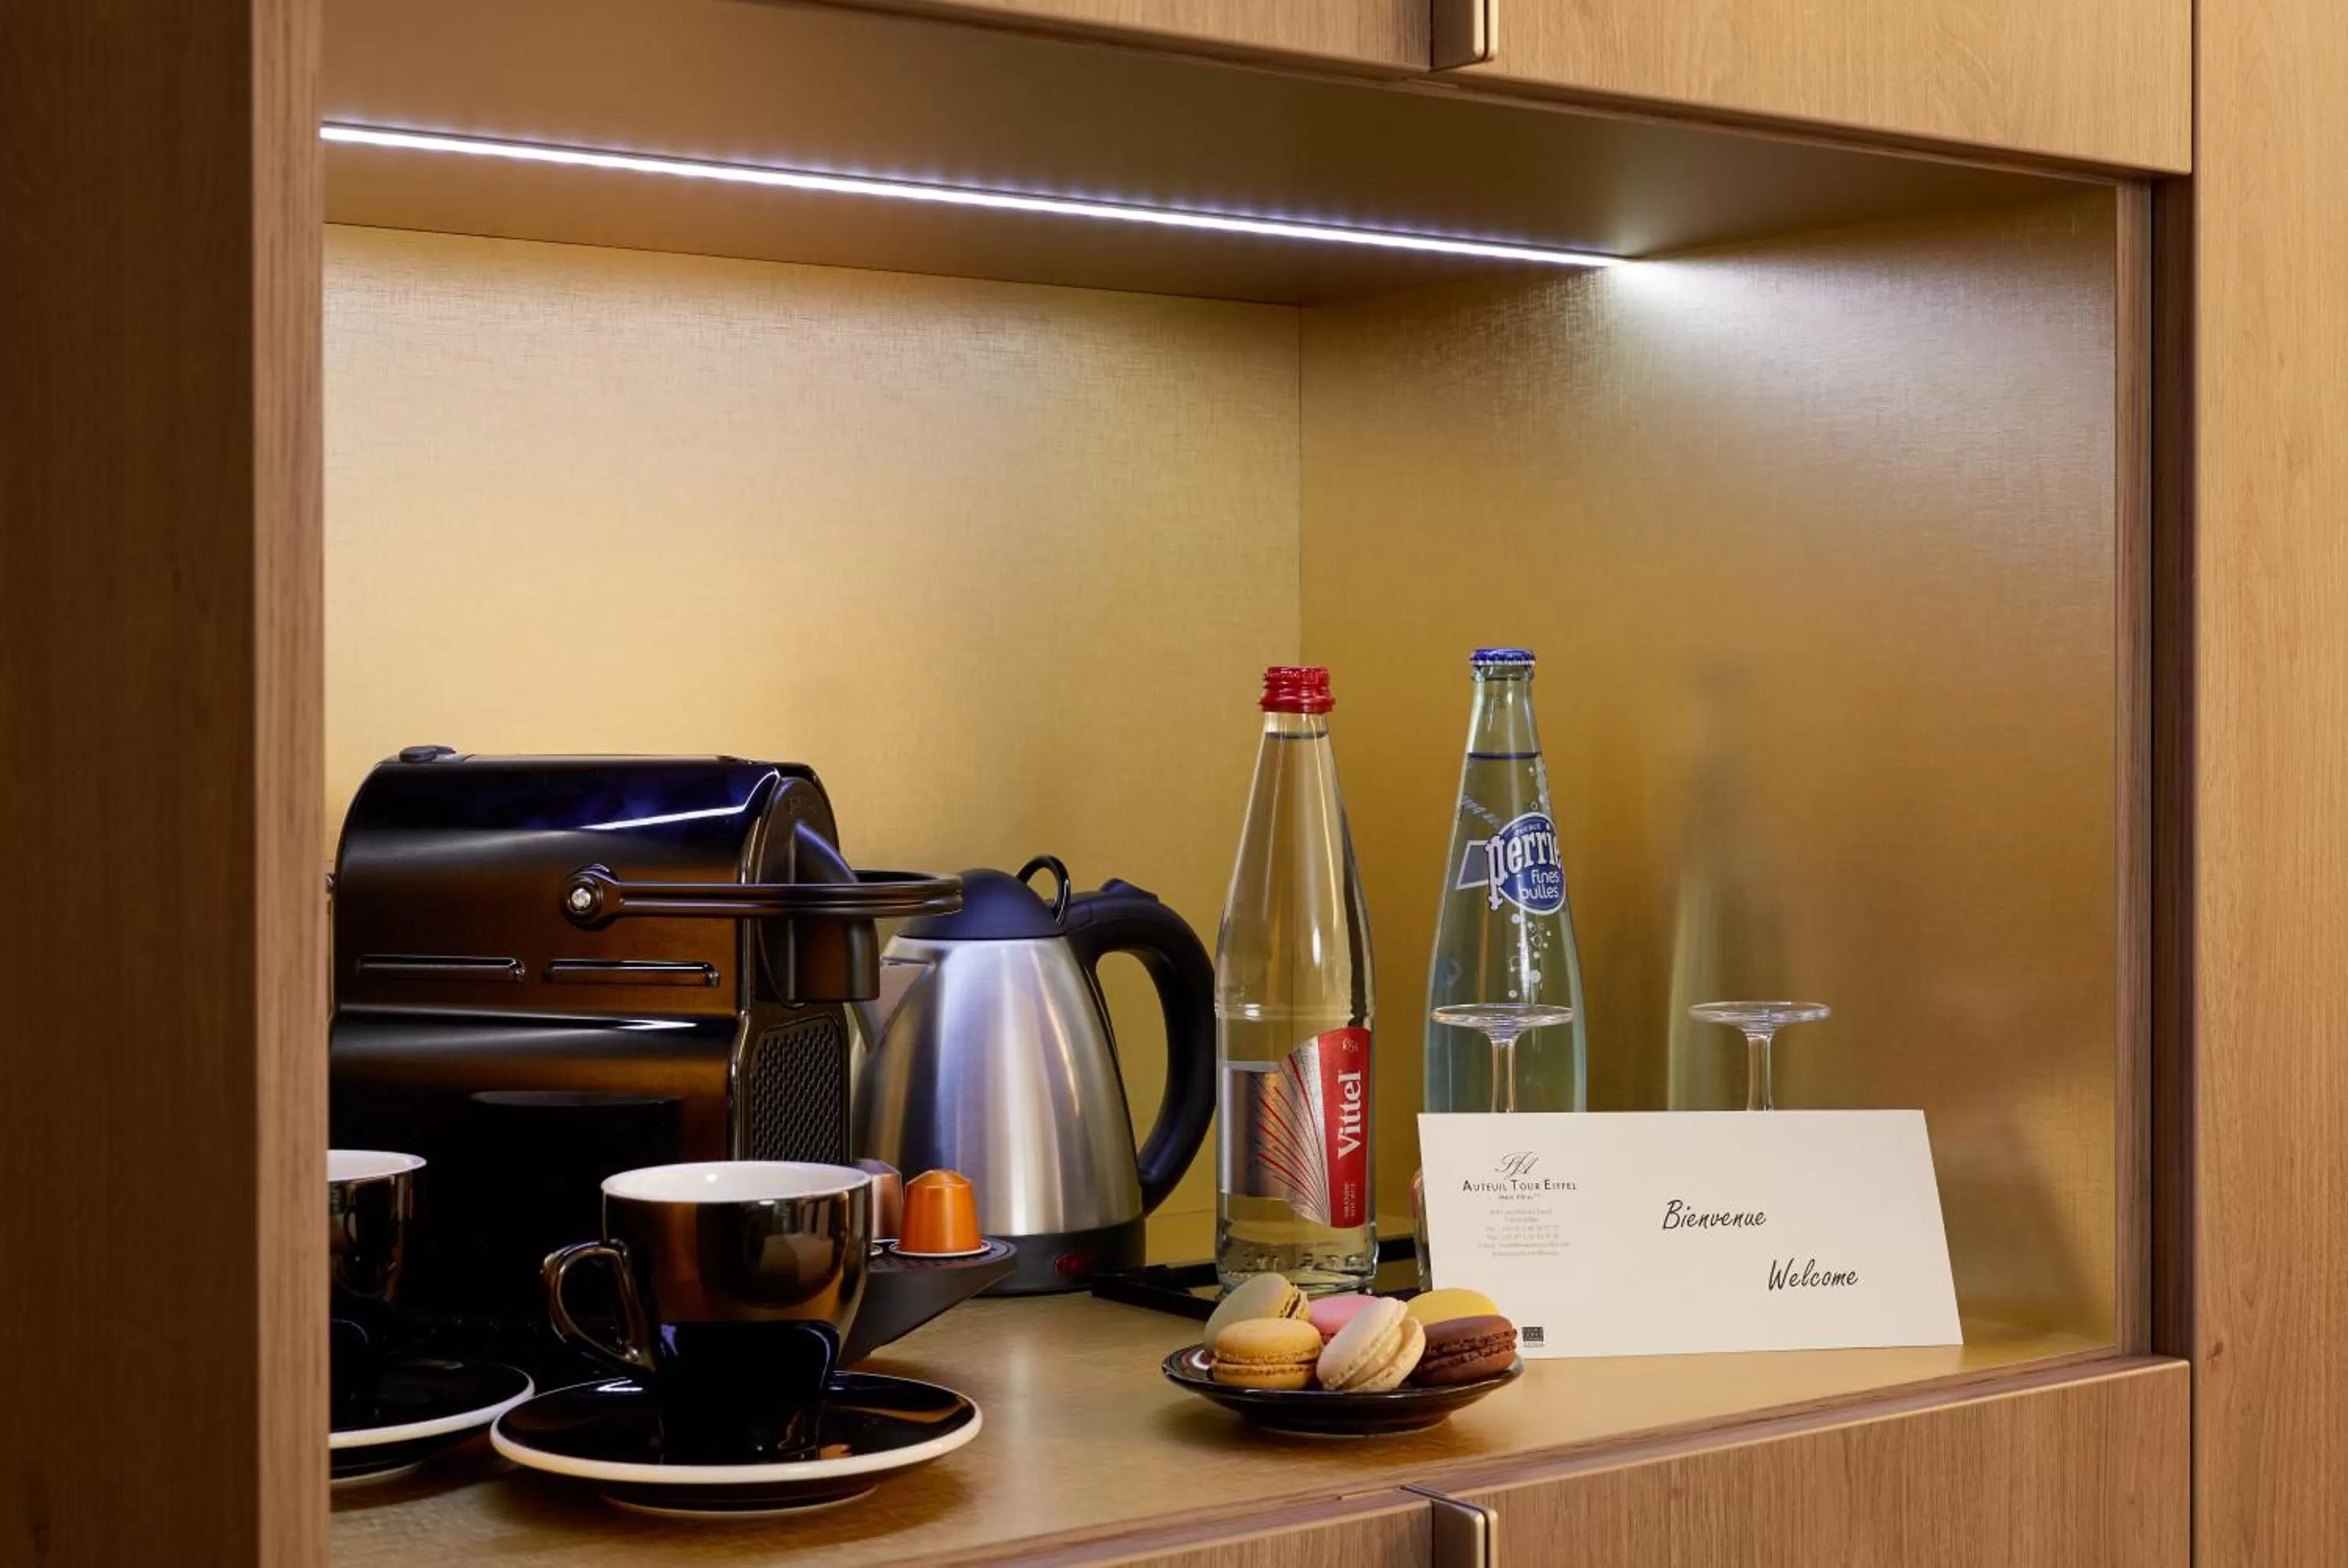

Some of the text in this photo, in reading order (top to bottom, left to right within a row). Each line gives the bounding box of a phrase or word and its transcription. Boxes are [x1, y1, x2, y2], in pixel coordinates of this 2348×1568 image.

[1486, 833, 1562, 910] perri
[1531, 869, 1560, 883] fines
[1519, 884, 1559, 899] bulles
[1338, 1069, 1362, 1160] Vittel
[1510, 1179, 1540, 1190] TOUR
[1662, 1199, 1766, 1230] Bienvenue
[1767, 1258, 1859, 1291] Welcome
